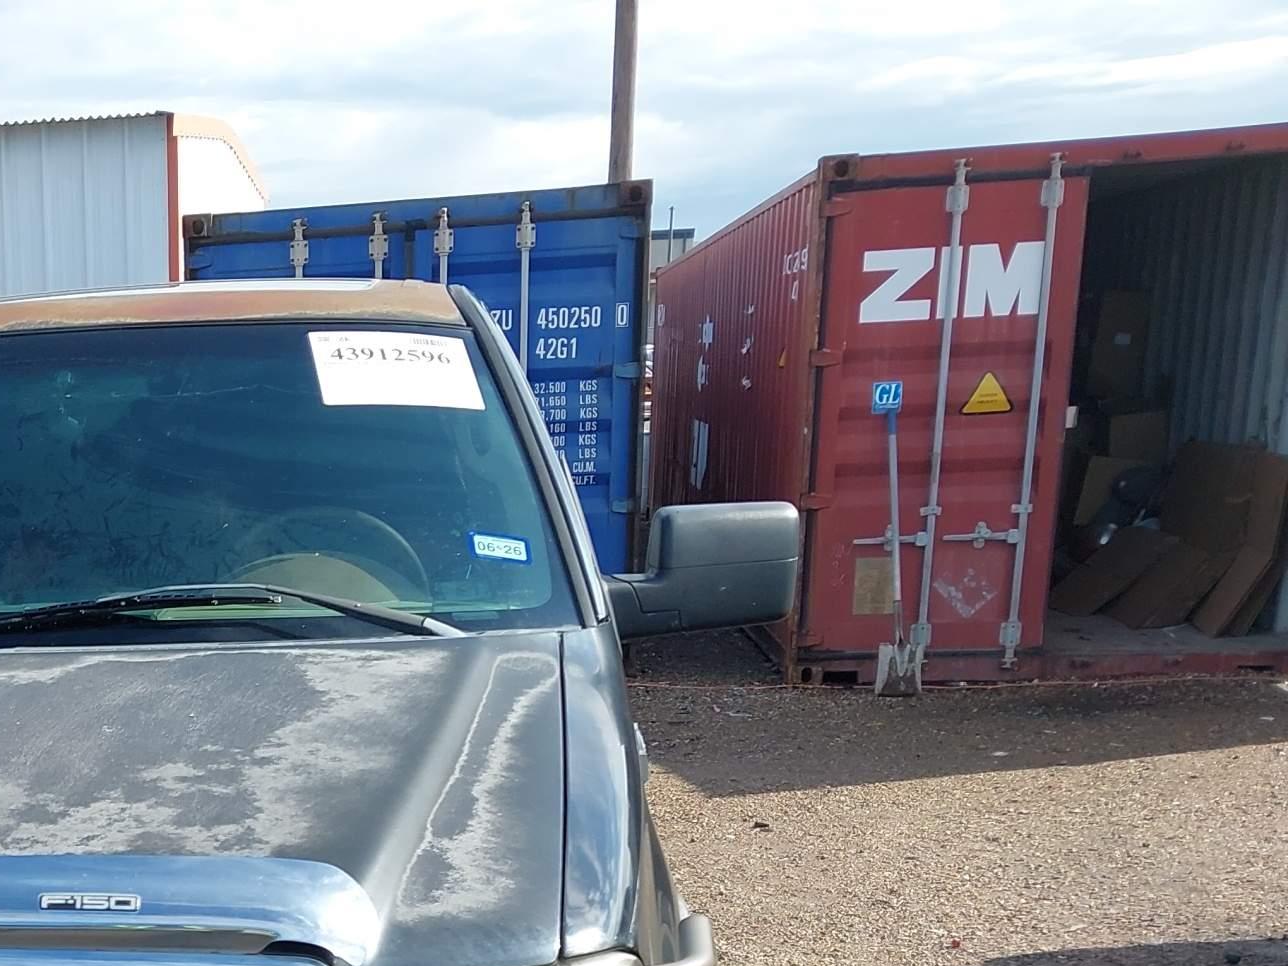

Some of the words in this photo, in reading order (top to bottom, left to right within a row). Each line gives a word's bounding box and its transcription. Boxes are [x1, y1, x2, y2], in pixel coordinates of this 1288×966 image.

[859, 241, 1046, 324] ZIM
[536, 306, 602, 329] 450250
[617, 304, 628, 327] 0
[330, 347, 451, 364] 43912596
[536, 338, 577, 359] 42G1
[534, 382, 567, 394] 32.500
[579, 380, 598, 392] KGS
[875, 383, 901, 405] GL
[579, 394, 598, 405] LBS
[579, 407, 598, 419] KGS
[579, 421, 598, 432] LBS
[551, 435, 565, 447] 00
[578, 434, 597, 446] KGS
[578, 447, 597, 459] LBS
[573, 461, 597, 473] CU.M.
[40, 894, 139, 911] F-150
